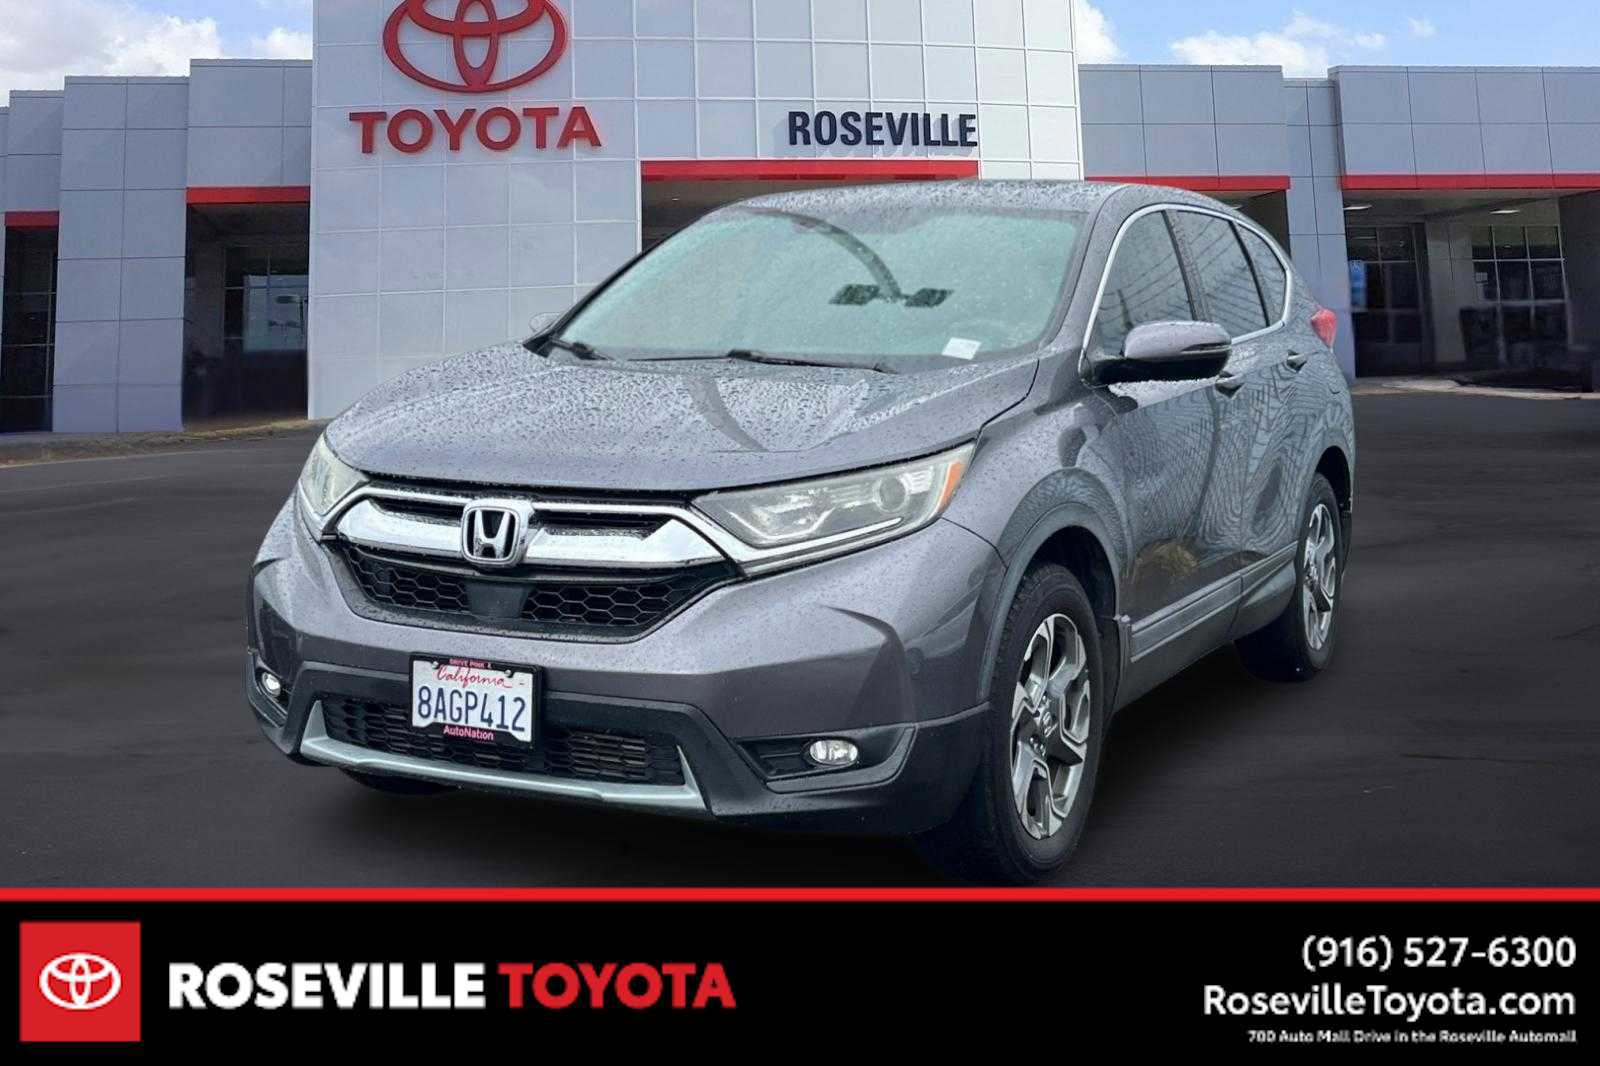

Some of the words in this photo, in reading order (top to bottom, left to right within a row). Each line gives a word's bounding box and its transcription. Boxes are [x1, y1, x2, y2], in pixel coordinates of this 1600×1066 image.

[349, 105, 603, 154] TOYOTA
[788, 110, 979, 147] ROSEVILLE
[437, 664, 513, 689] California
[418, 685, 525, 732] 8AGP412
[443, 725, 494, 741] AutoNation
